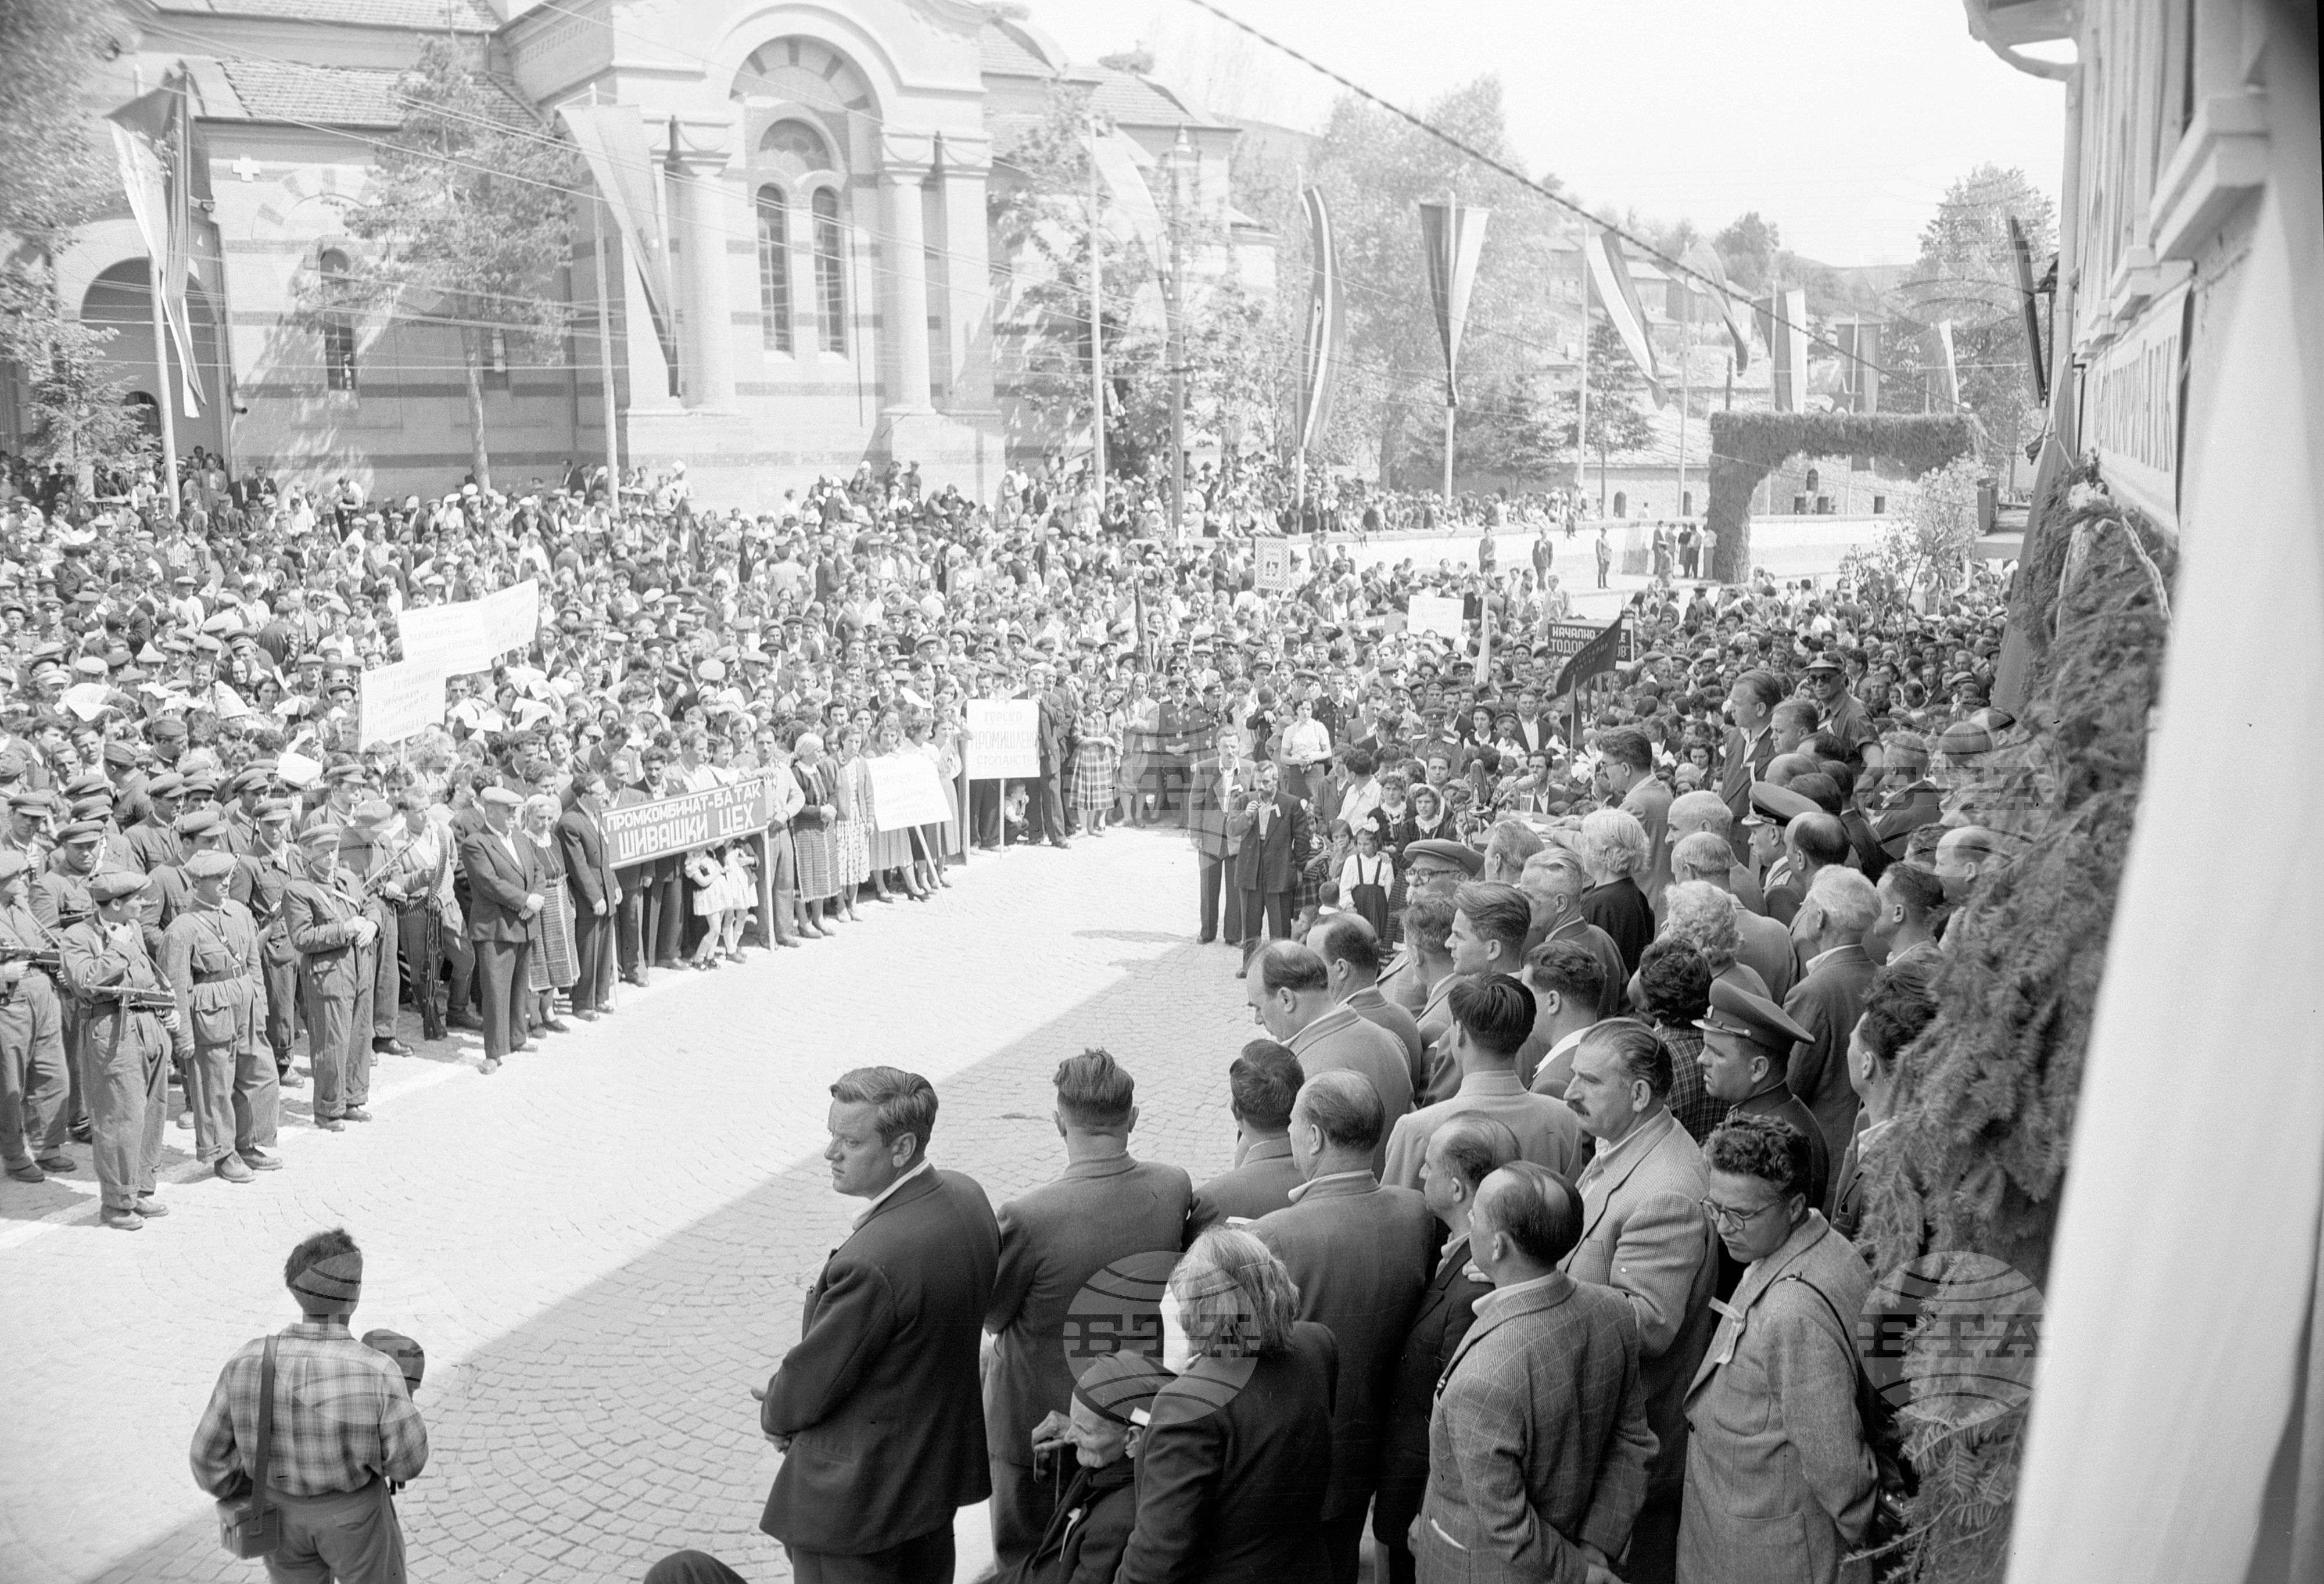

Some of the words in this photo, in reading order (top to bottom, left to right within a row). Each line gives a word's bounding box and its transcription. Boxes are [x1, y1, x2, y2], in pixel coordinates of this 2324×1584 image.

[984, 710, 1023, 723] ГОРСКО
[976, 754, 1038, 766] СТОПАНСТВО
[618, 814, 709, 860] ШИВАШКИ
[719, 802, 755, 838] ЦЕХ
